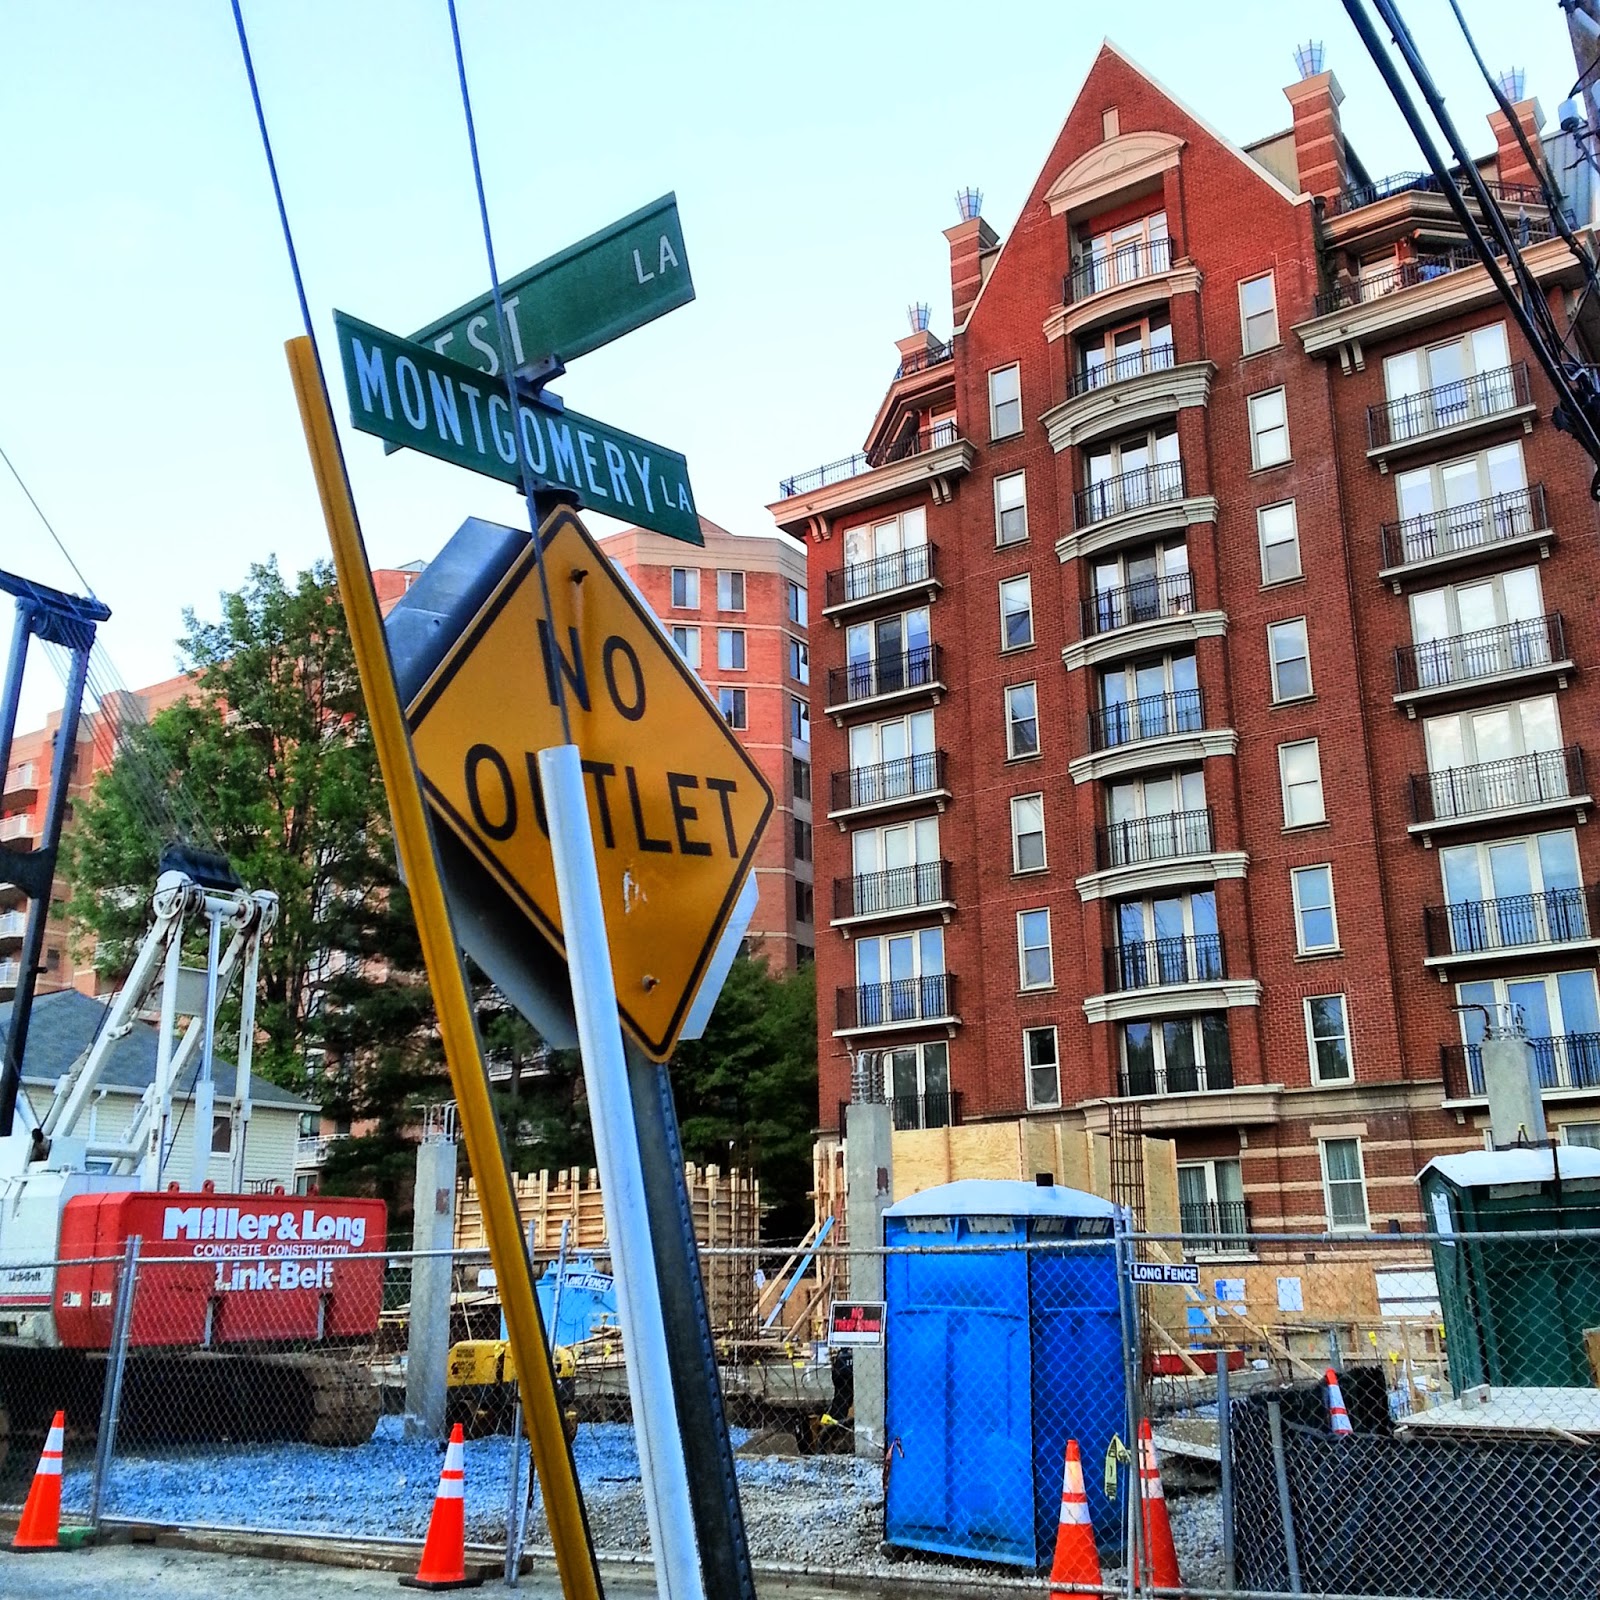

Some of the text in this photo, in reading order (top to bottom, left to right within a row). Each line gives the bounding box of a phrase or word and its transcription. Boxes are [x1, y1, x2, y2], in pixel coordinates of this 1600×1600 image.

[633, 234, 679, 284] LA
[351, 336, 693, 515] MONTGOMERY LA
[535, 618, 646, 722] NO
[193, 1243, 349, 1257] CONCRETE CONSTRUCTION
[215, 1260, 334, 1291] Link-Belt
[583, 1274, 612, 1290] FENCE
[1133, 1264, 1197, 1282] LONG FENCE
